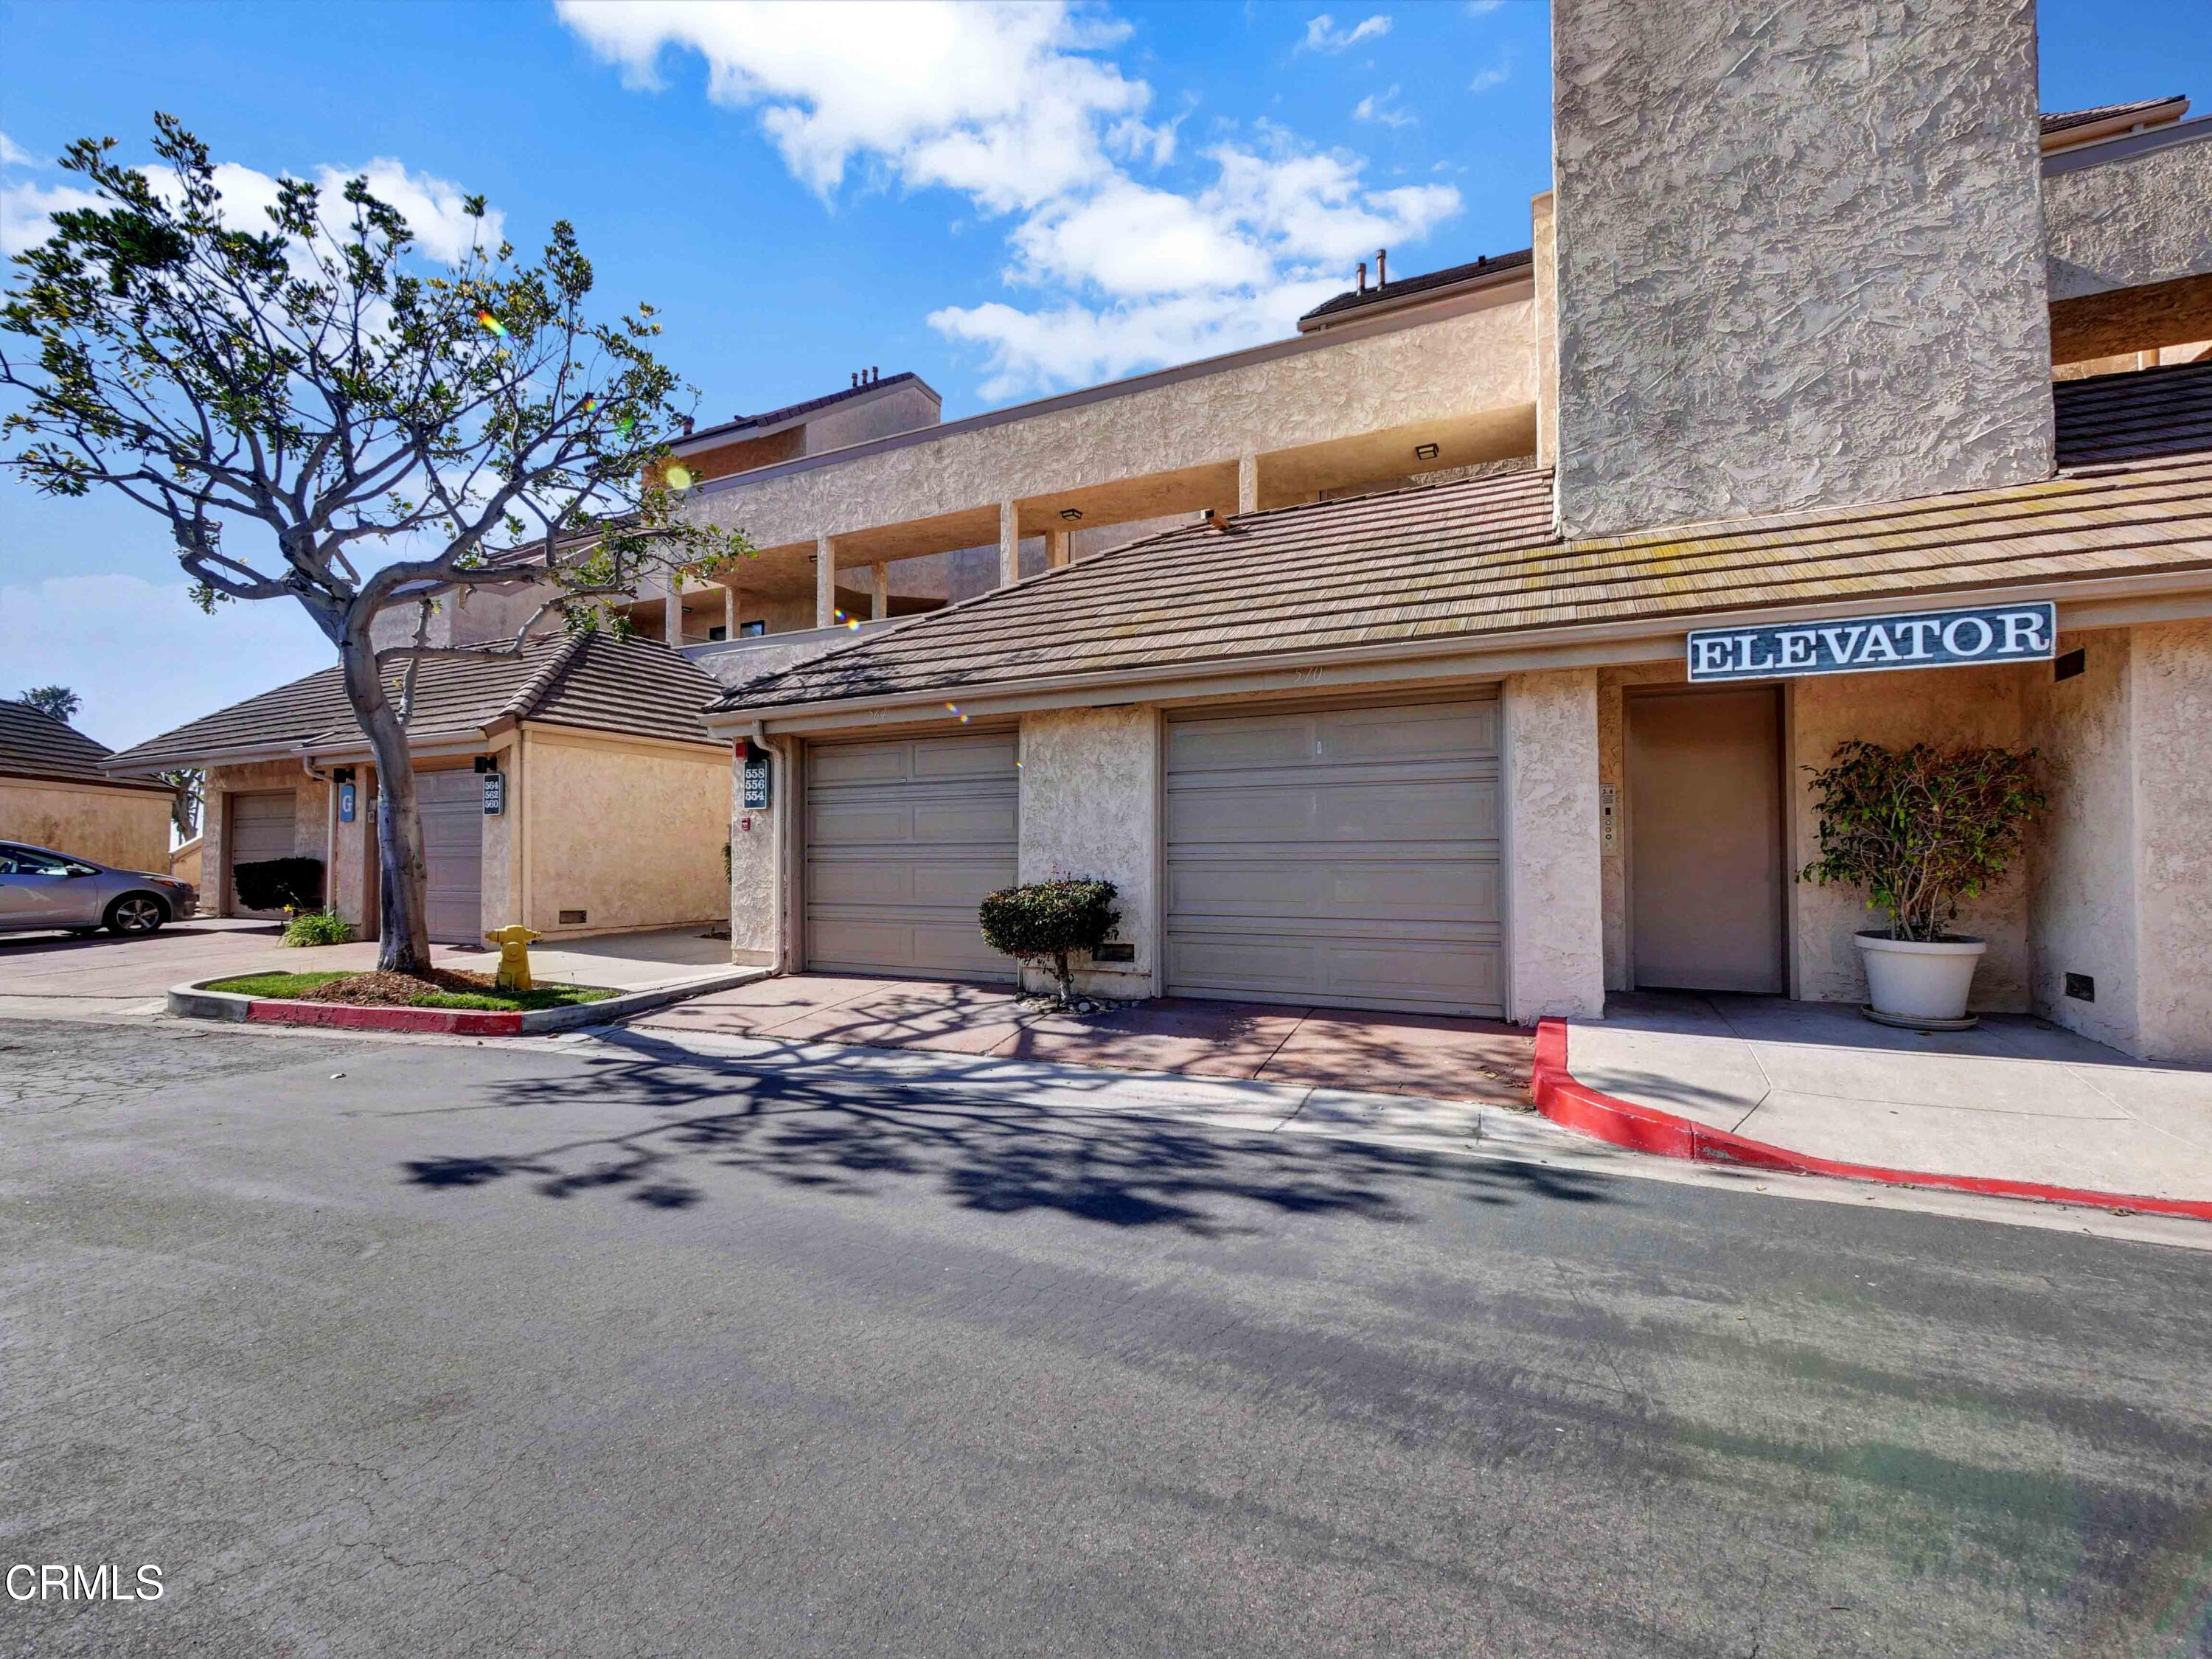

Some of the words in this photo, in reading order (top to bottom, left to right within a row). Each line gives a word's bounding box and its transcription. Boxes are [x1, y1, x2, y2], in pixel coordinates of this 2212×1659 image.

[1692, 611, 2051, 674] ELEVATOR
[745, 768, 765, 779] 558
[484, 781, 498, 790] 564
[745, 779, 765, 790] 556
[484, 790, 498, 799] 562
[745, 790, 765, 801] 554
[342, 795, 352, 813] G
[484, 799, 498, 808] 560
